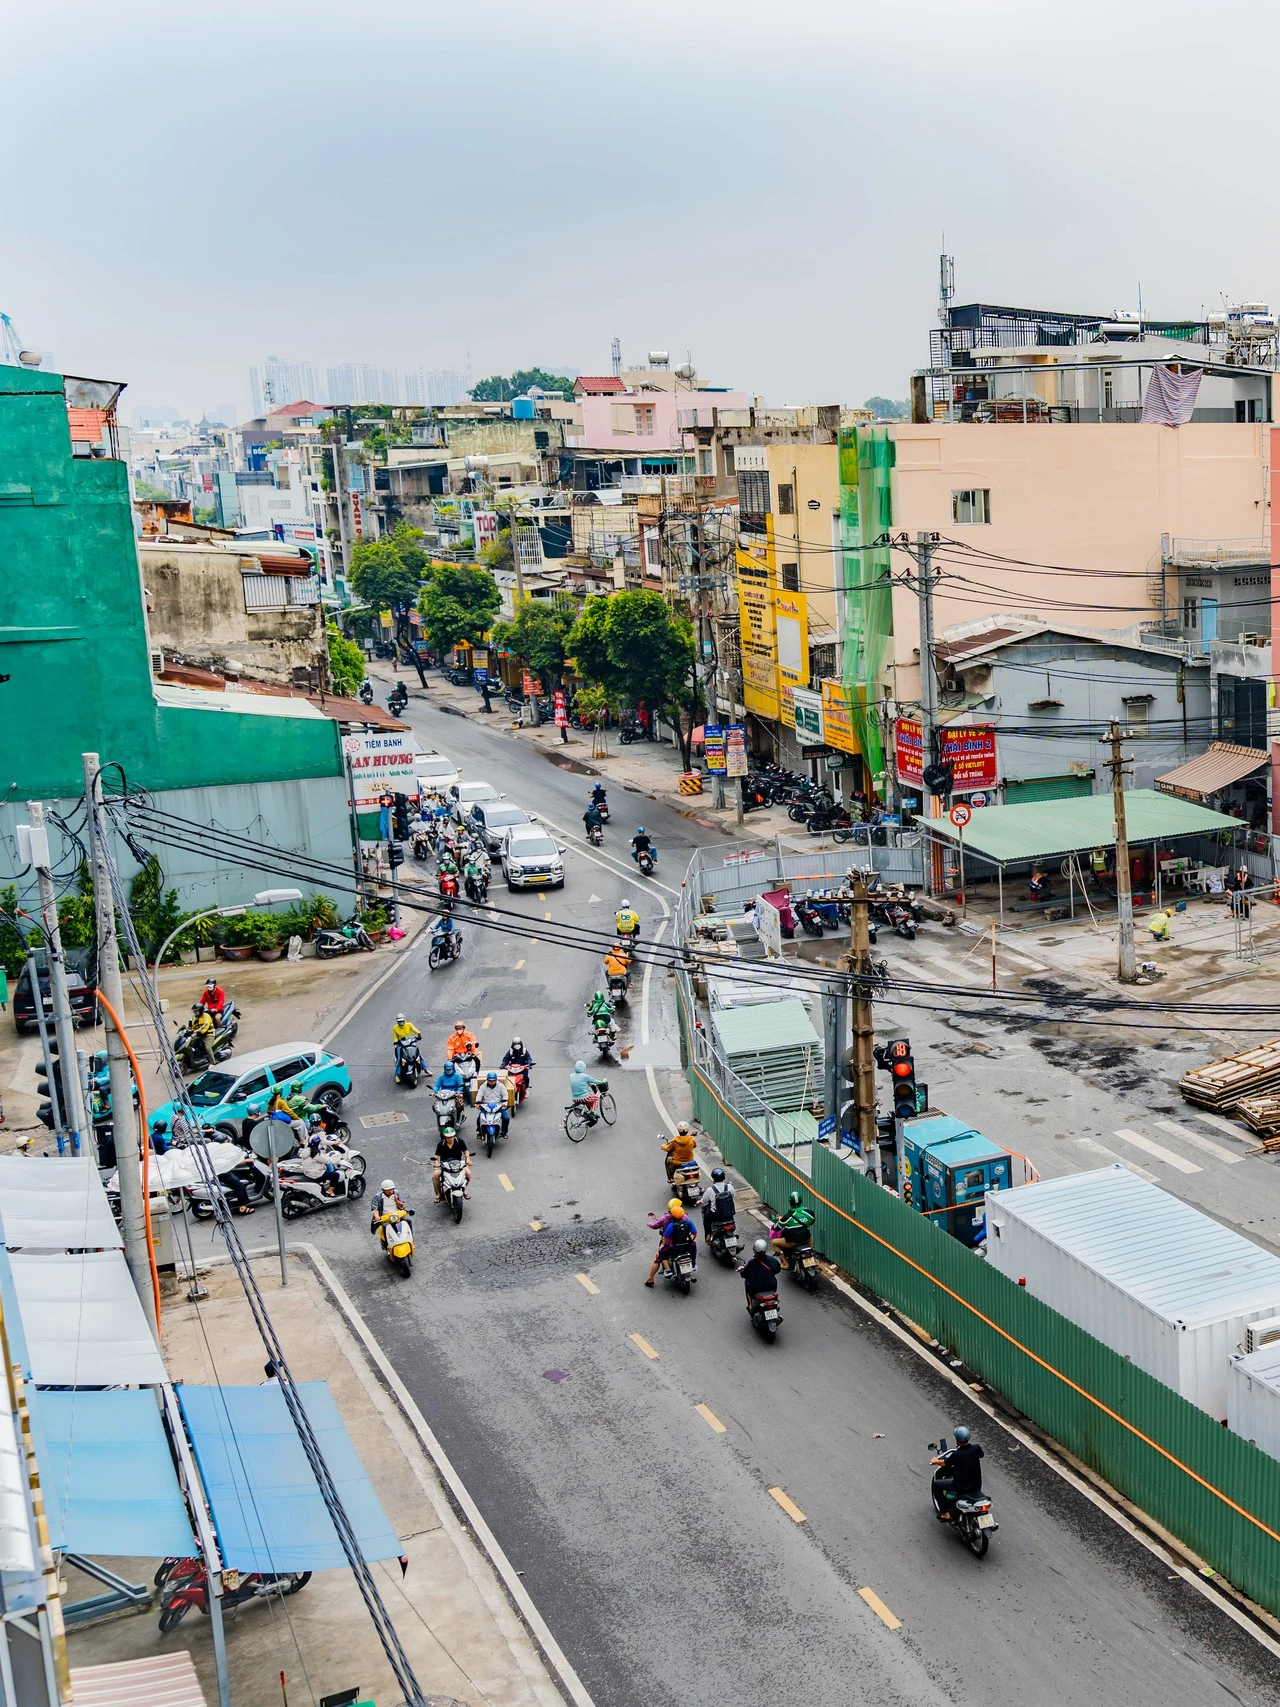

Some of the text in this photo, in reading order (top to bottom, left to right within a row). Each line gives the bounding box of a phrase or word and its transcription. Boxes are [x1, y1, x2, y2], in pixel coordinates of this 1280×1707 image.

[964, 739, 983, 752] BÌNH
[986, 739, 992, 750] 2
[352, 756, 371, 769] AN
